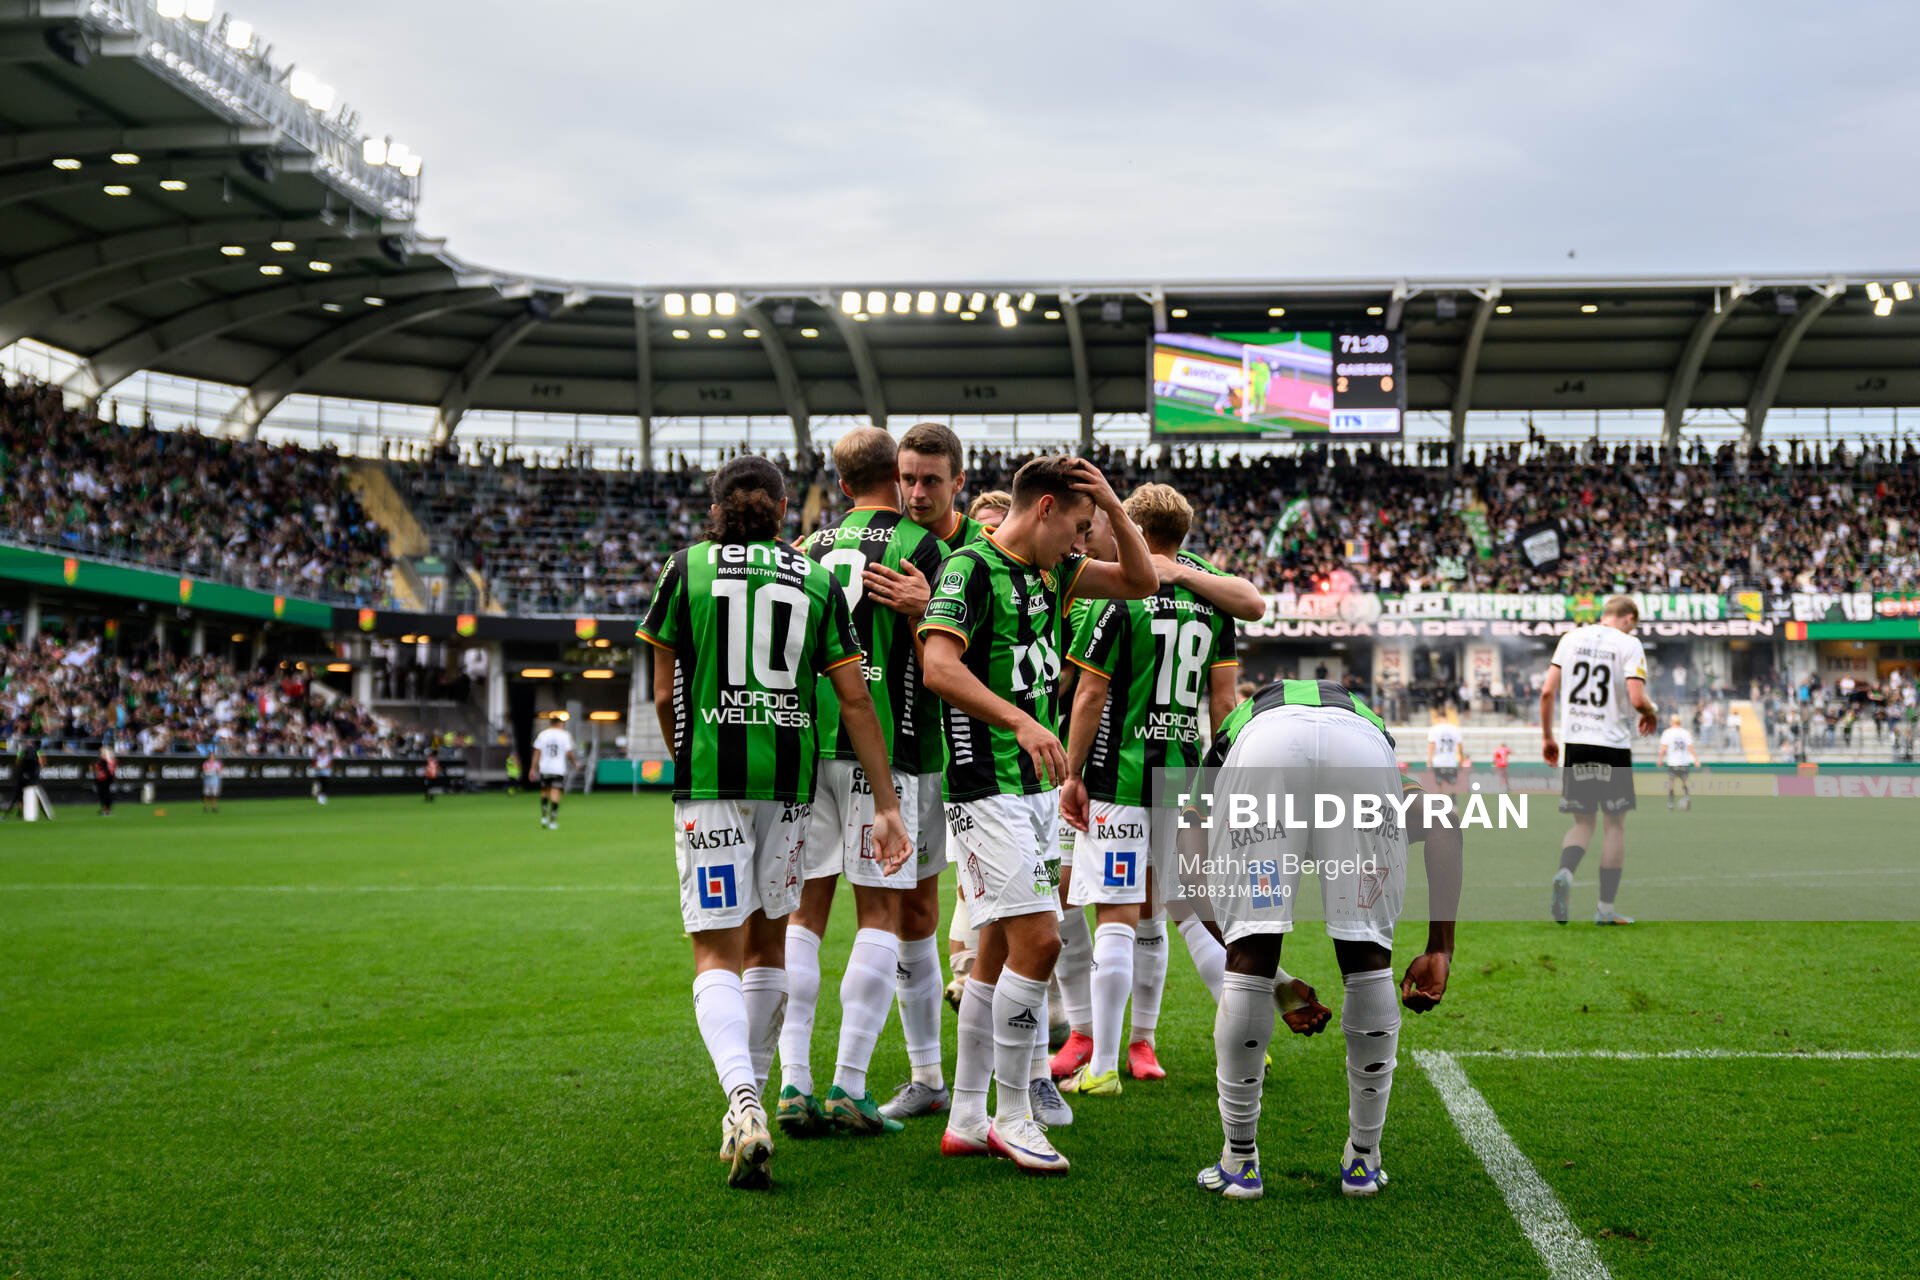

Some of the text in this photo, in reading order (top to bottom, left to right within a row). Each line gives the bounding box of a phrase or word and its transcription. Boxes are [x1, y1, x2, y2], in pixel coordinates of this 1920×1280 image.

[1336, 376, 1348, 393] 2
[707, 543, 812, 577] renta
[718, 567, 802, 585] MASKINUTHYRNING
[930, 601, 965, 614] UNIBET
[1098, 604, 1116, 628] Group
[711, 579, 811, 690] 10
[1150, 619, 1213, 708] 78
[1569, 660, 1611, 709] 23
[720, 690, 799, 711] NORDIC
[701, 707, 811, 729] WELLNESS
[687, 827, 746, 850] RASTA
[1097, 823, 1144, 840] RASTA
